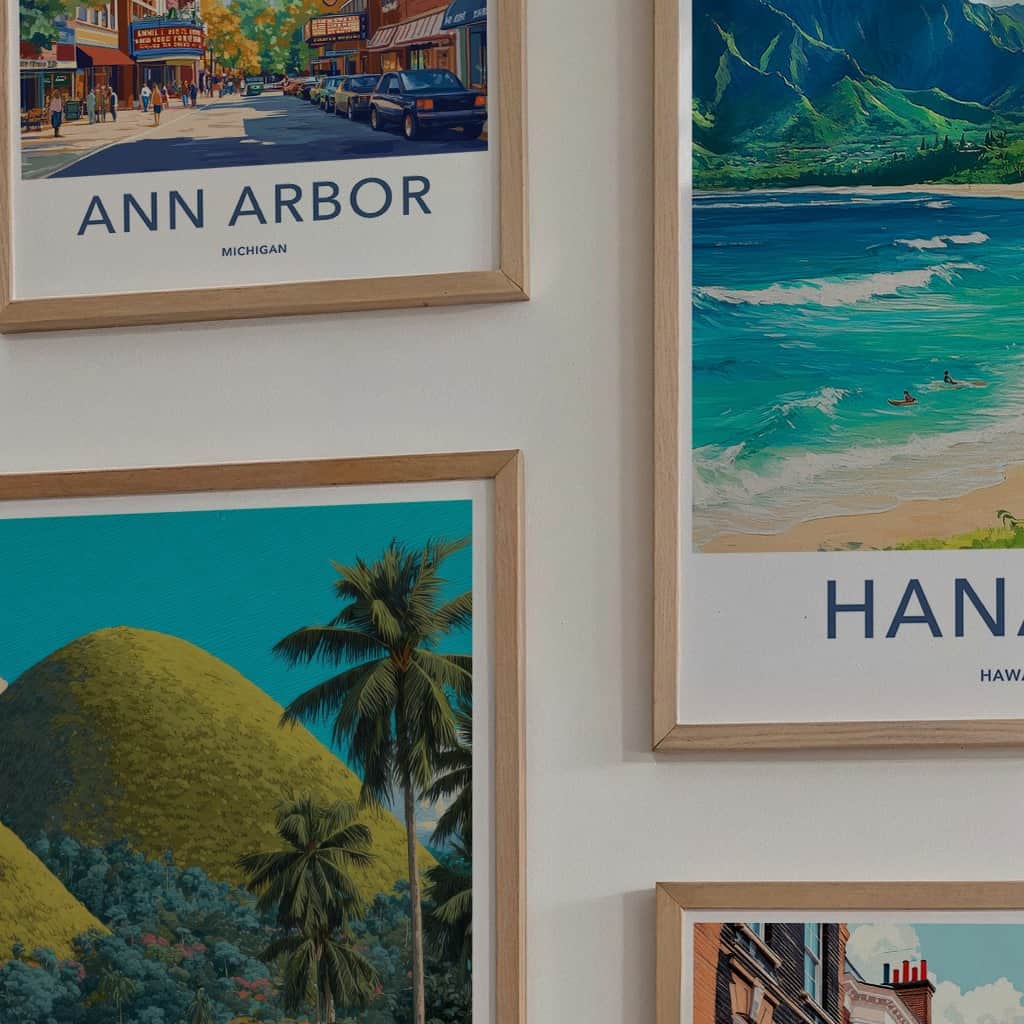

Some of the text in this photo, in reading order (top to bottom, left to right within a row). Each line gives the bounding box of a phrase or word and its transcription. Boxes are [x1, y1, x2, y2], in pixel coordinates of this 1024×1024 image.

[77, 175, 432, 236] ANN ARBOR
[221, 244, 288, 257] MICHIGAN
[827, 577, 1024, 639] HAN
[980, 668, 1024, 682] HAW
